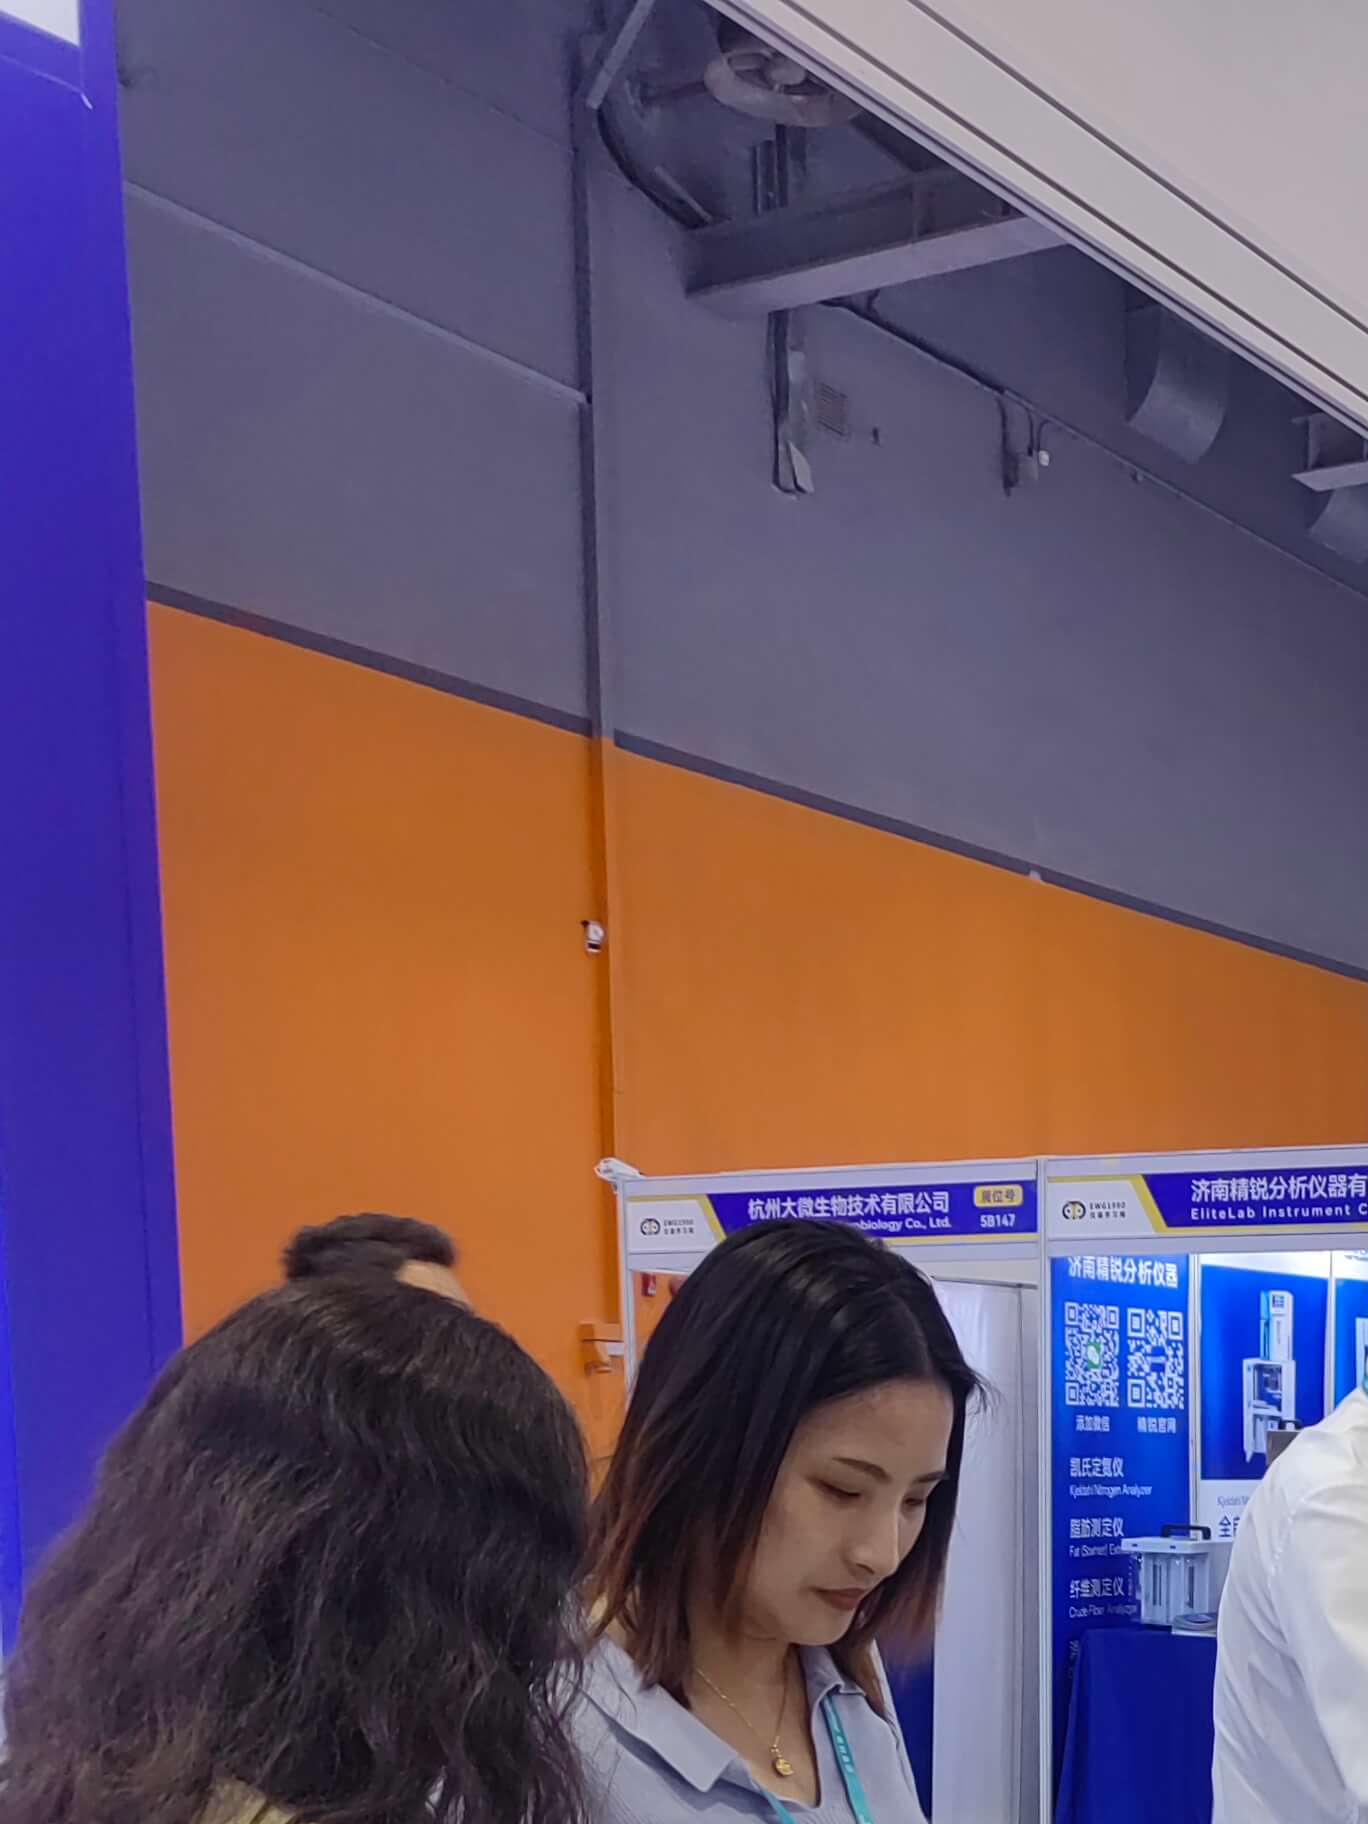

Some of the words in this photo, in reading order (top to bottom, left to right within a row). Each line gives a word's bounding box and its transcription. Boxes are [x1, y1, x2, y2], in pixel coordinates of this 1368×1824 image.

[747, 1191, 950, 1220] 杭州大微生物技术有限公司
[1191, 1205, 1256, 1220] EliteLab
[1262, 1203, 1351, 1218] Instrument
[929, 1216, 952, 1228] Ltd.
